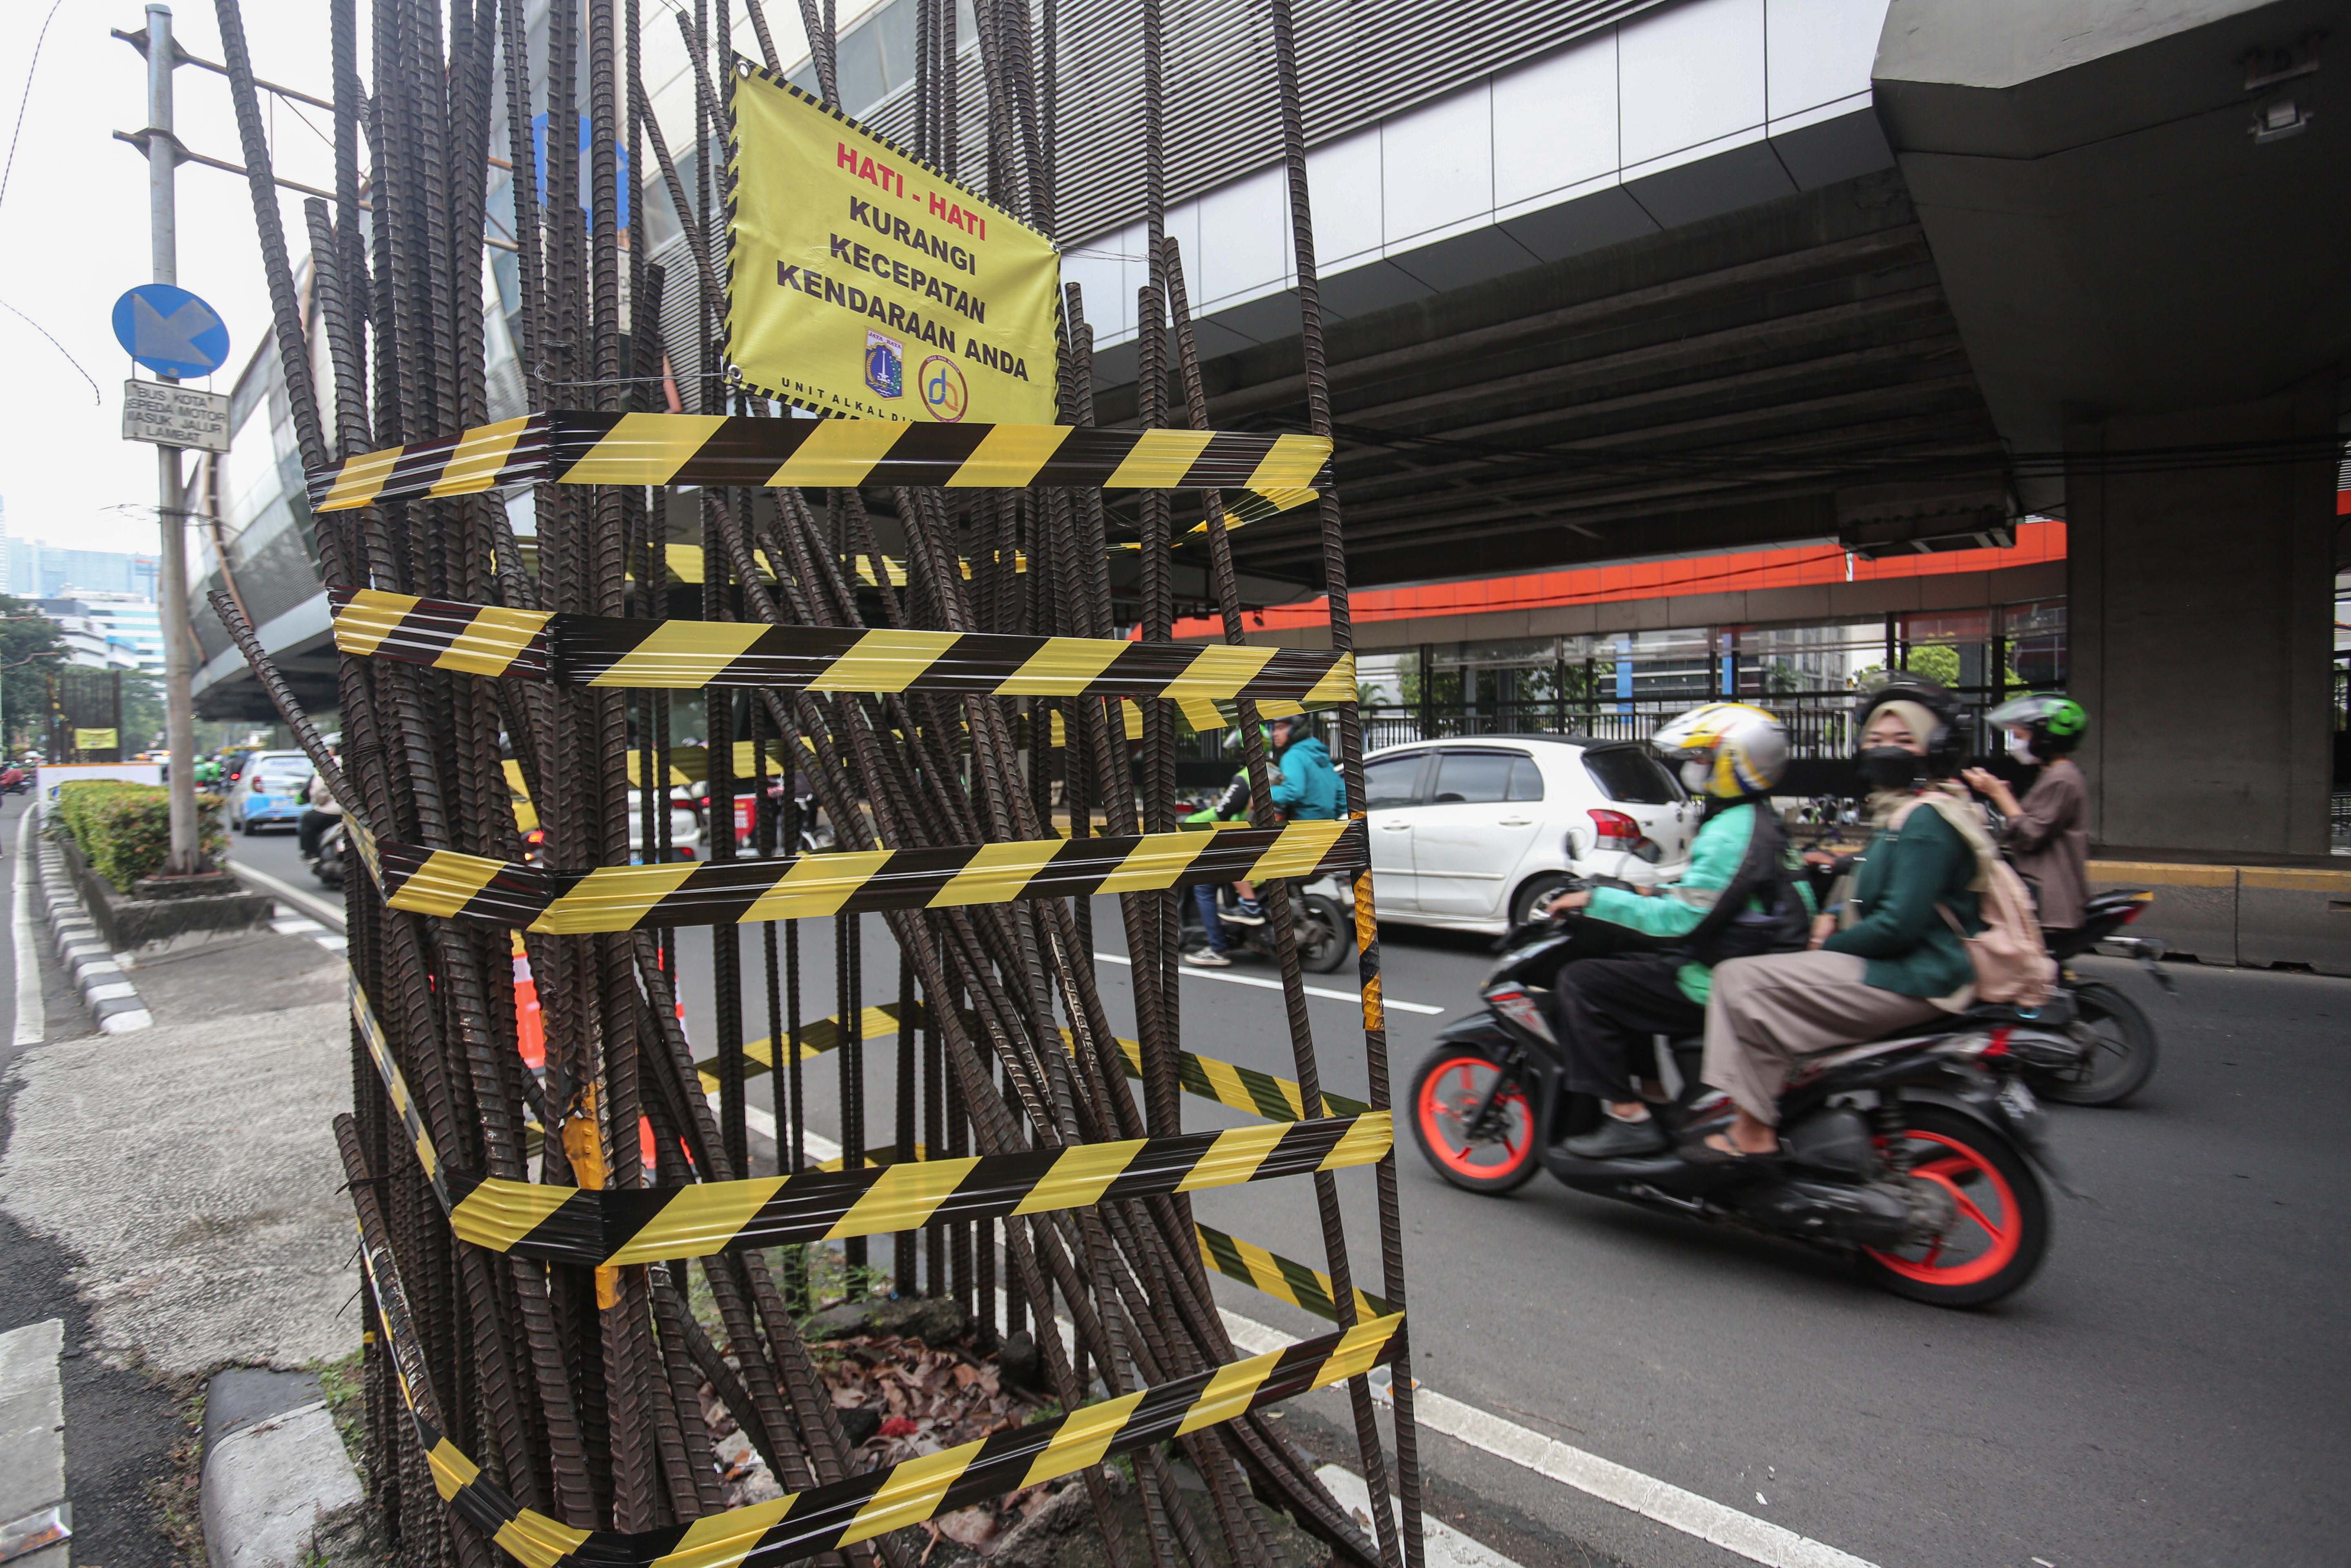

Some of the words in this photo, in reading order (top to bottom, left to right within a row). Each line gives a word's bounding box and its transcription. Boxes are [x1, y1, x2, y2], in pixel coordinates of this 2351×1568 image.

[837, 142, 903, 198] HATI
[912, 194, 920, 202] -
[929, 192, 985, 241] HATI
[850, 195, 976, 276] KURANGI
[830, 232, 986, 324] KECEPATAN
[777, 259, 956, 354] KENDARAAN
[965, 338, 1029, 382] ANDA
[868, 332, 883, 342] JAYA
[886, 339, 902, 349] RAYA
[127, 398, 174, 414] SEPEDA
[178, 406, 227, 422] MOTOR
[137, 387, 165, 401] BUS
[172, 393, 208, 408] KOTA
[781, 377, 825, 399] UNIT
[832, 394, 885, 418] ALKAL
[127, 411, 173, 426] MASUK
[180, 418, 222, 434] JALUR
[145, 425, 201, 442] LAMBAT
